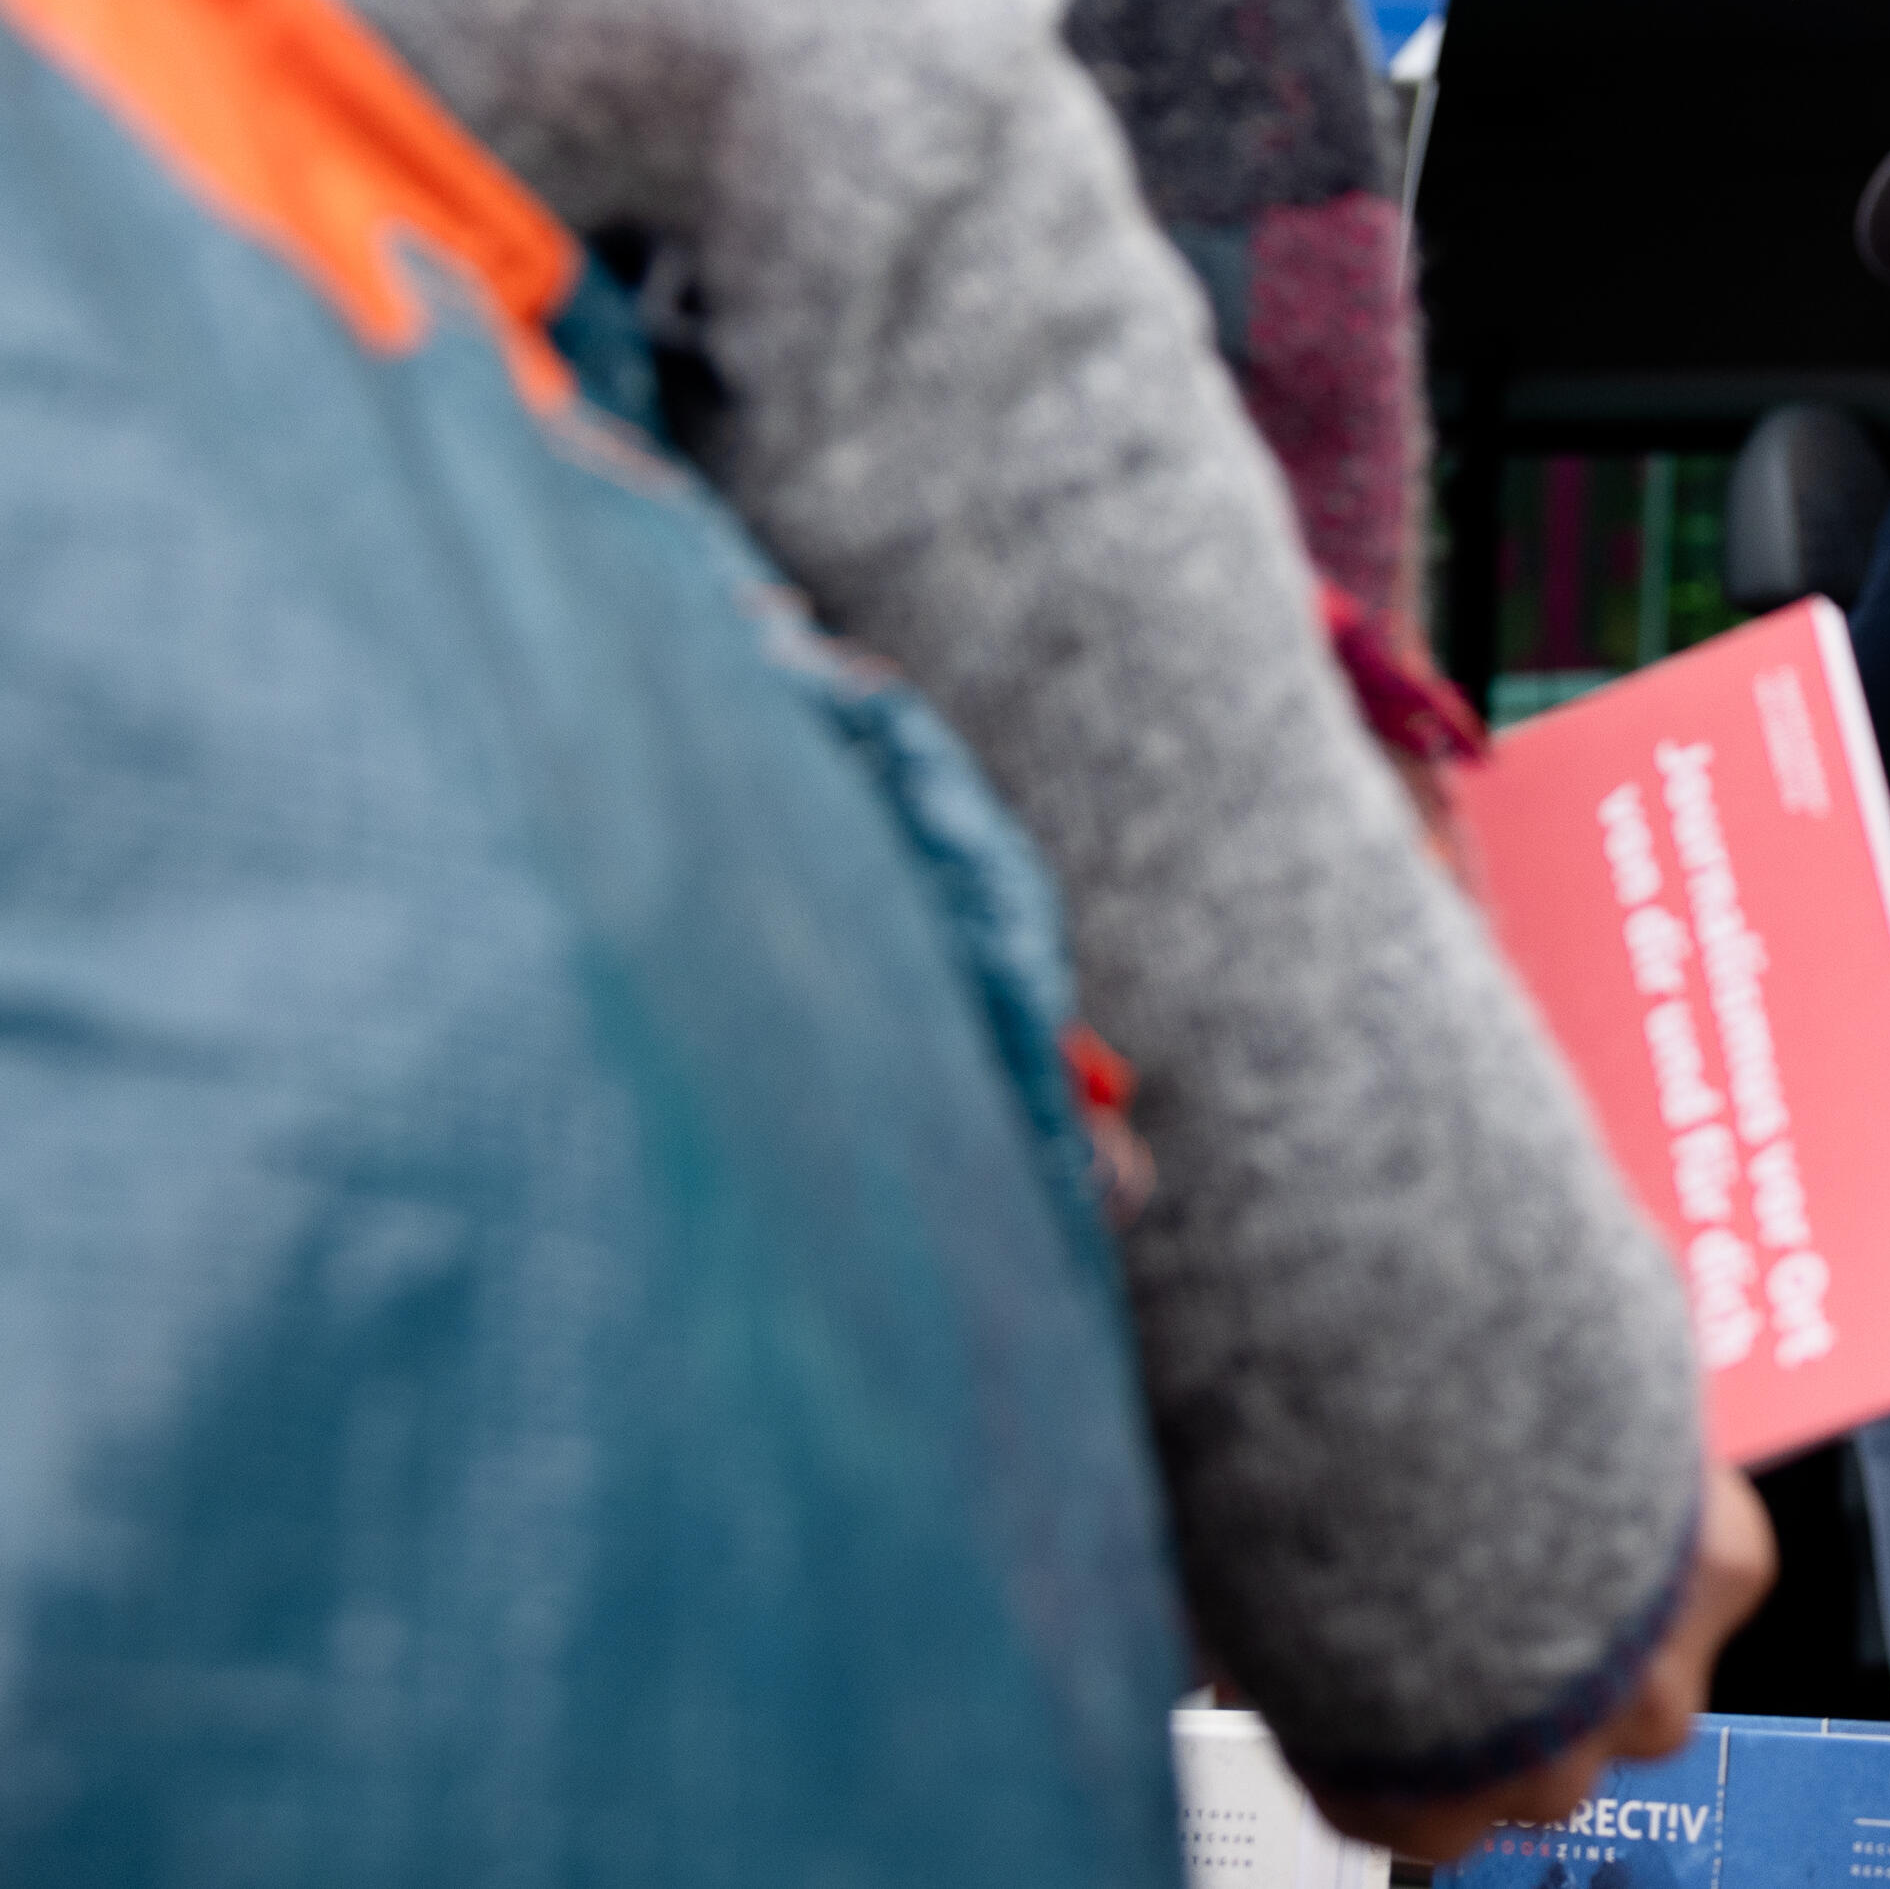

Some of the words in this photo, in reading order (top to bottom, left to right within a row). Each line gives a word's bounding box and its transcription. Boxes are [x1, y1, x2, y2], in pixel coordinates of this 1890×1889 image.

[1599, 780, 1662, 907] von
[1624, 904, 1693, 996] dir
[1656, 739, 1789, 1146] Journalismus
[1643, 1000, 1724, 1129] und
[1668, 1122, 1742, 1223] für
[1746, 1139, 1812, 1248] vor
[1687, 1226, 1760, 1372] dich
[1766, 1250, 1834, 1370] Ort
